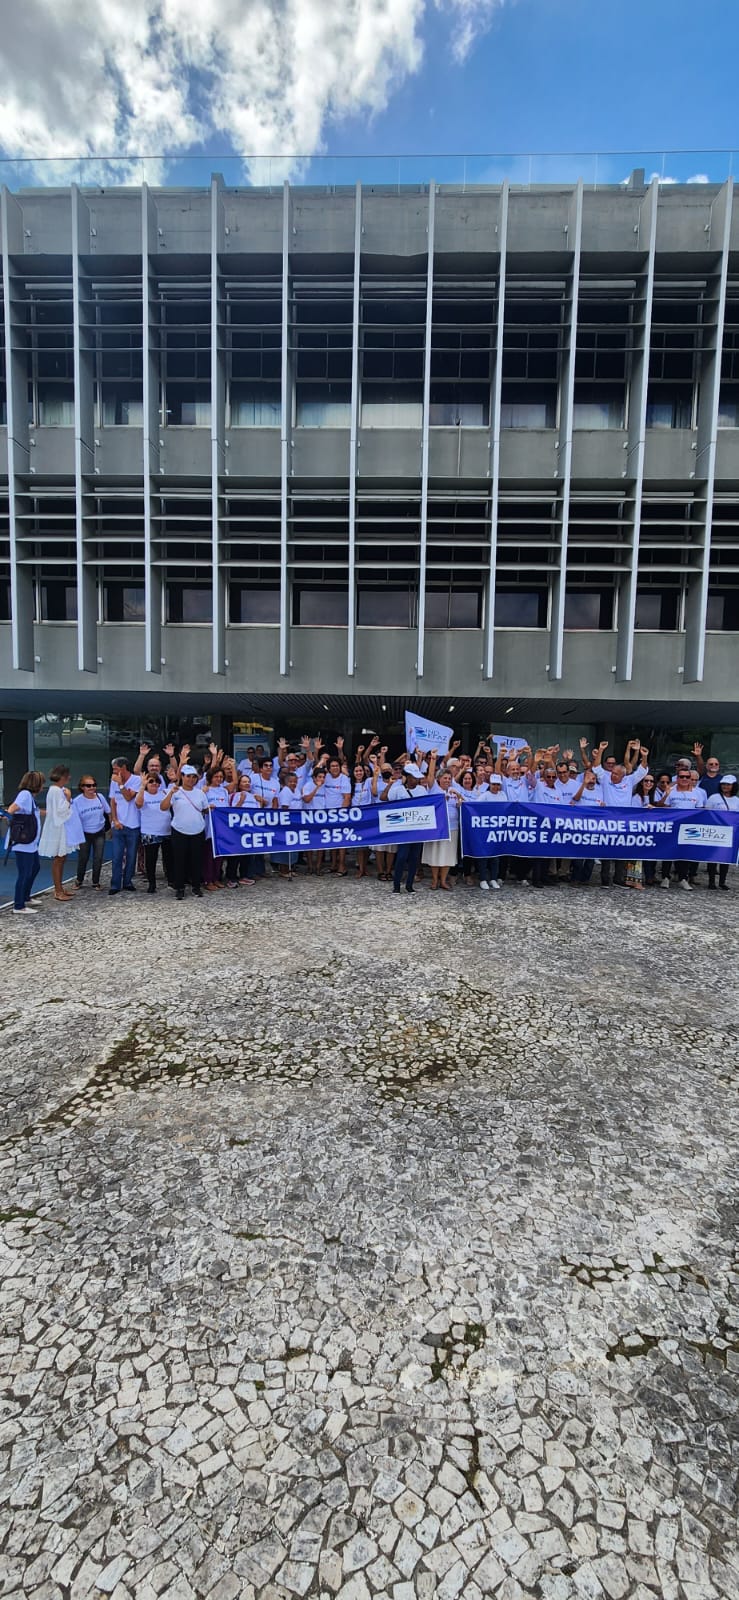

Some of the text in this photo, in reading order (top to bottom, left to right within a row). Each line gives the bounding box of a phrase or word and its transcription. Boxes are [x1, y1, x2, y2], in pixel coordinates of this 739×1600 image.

[228, 807, 362, 828] PAGUE NOSSO
[471, 815, 674, 833] RESPEITE A PARIDADE ENTRE
[240, 828, 362, 849] CET DE 35%.
[486, 830, 656, 847] ATIVOS E APOSENTADOS.
